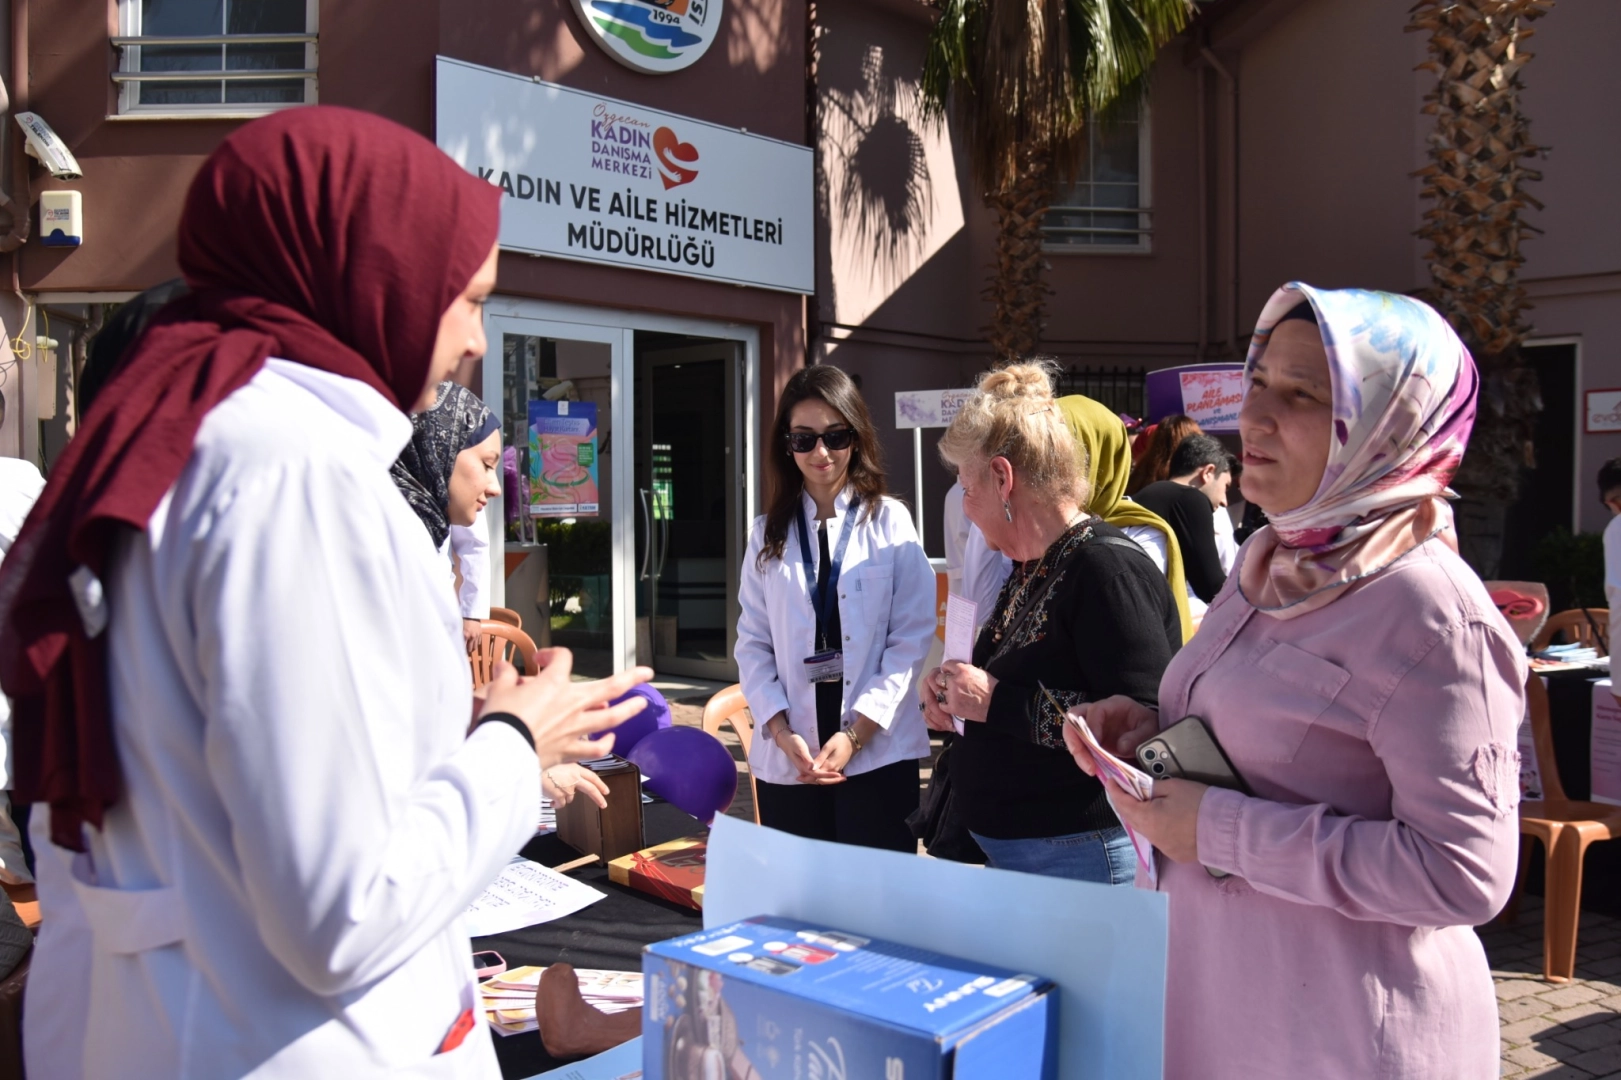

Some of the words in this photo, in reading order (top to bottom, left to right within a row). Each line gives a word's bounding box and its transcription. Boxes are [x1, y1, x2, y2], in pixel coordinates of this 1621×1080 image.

[653, 8, 681, 24] 1994
[593, 102, 651, 131] Özgecan
[591, 119, 651, 150] KADIN
[592, 140, 652, 165] DANIŞMA
[591, 156, 652, 180] MERKEZİ
[569, 183, 601, 213] VE
[608, 187, 658, 223] AİLE
[665, 198, 783, 245] HİZMETLERİ
[567, 220, 715, 269] MÜDÜRLÜĞÜ
[1202, 386, 1222, 399] AİLE
